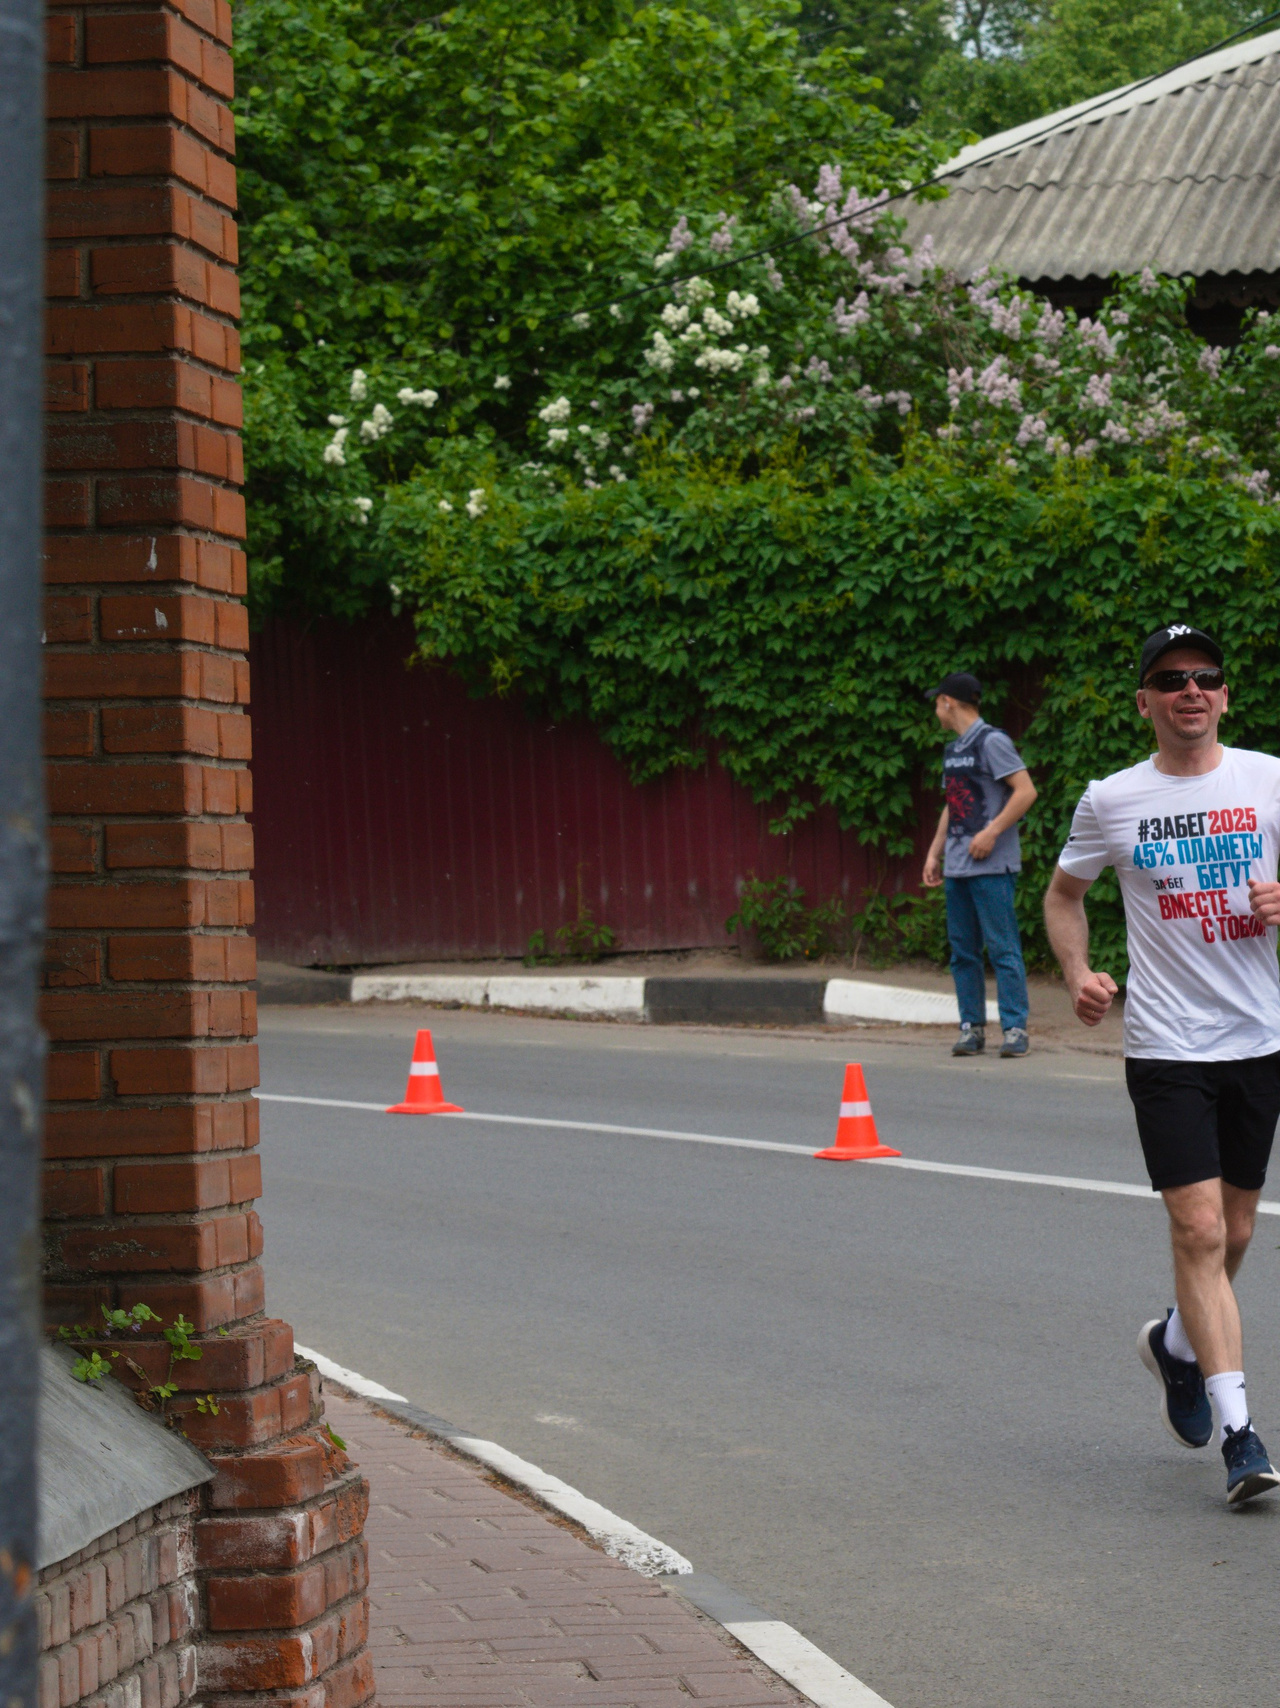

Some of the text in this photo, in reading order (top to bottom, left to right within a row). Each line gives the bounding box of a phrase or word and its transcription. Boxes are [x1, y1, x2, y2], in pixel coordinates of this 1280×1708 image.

[1134, 833, 1262, 870] 45% ПЛАНЕТЫ
[1196, 861, 1252, 889] БЕГУТ
[1157, 890, 1231, 920] ВМЕСТЕ
[1201, 917, 1215, 943] С
